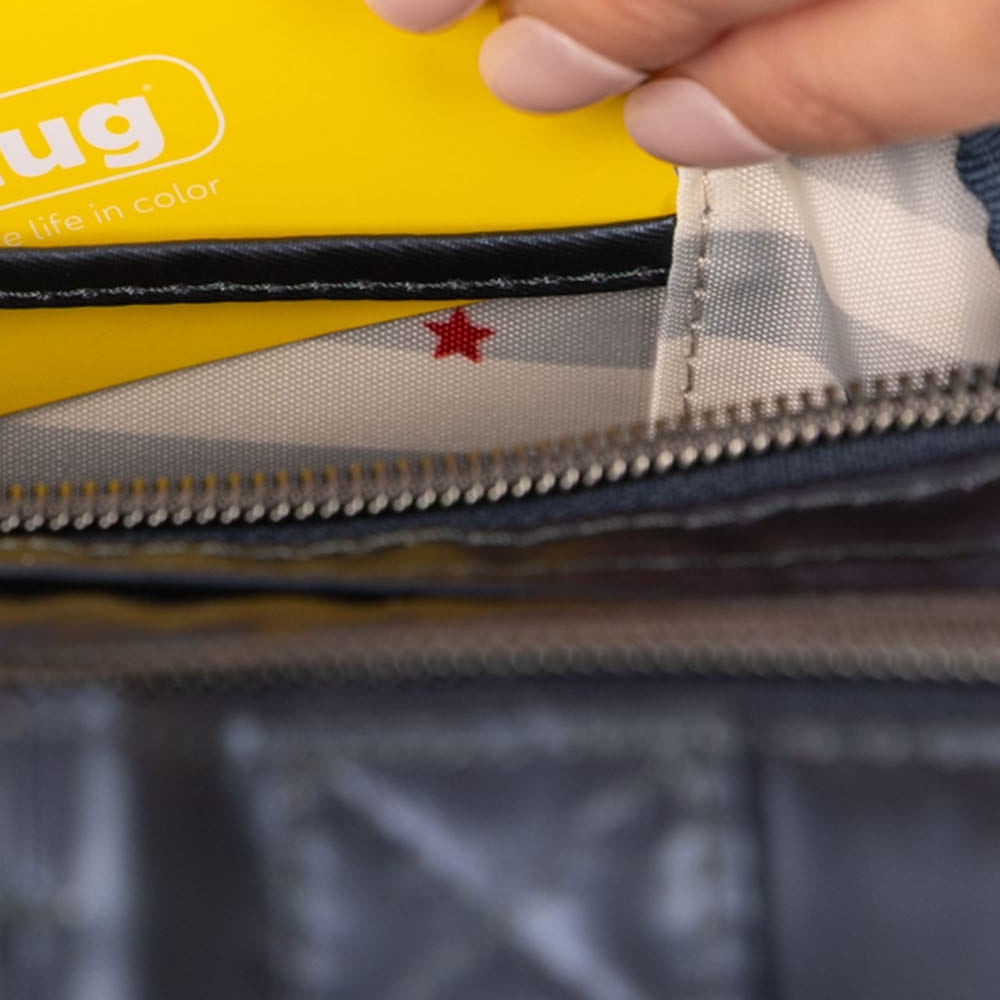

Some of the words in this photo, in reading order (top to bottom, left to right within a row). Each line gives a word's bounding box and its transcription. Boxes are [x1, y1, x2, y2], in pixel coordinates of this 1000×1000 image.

[28, 213, 84, 241] life
[89, 203, 124, 224] in
[133, 176, 220, 214] color
